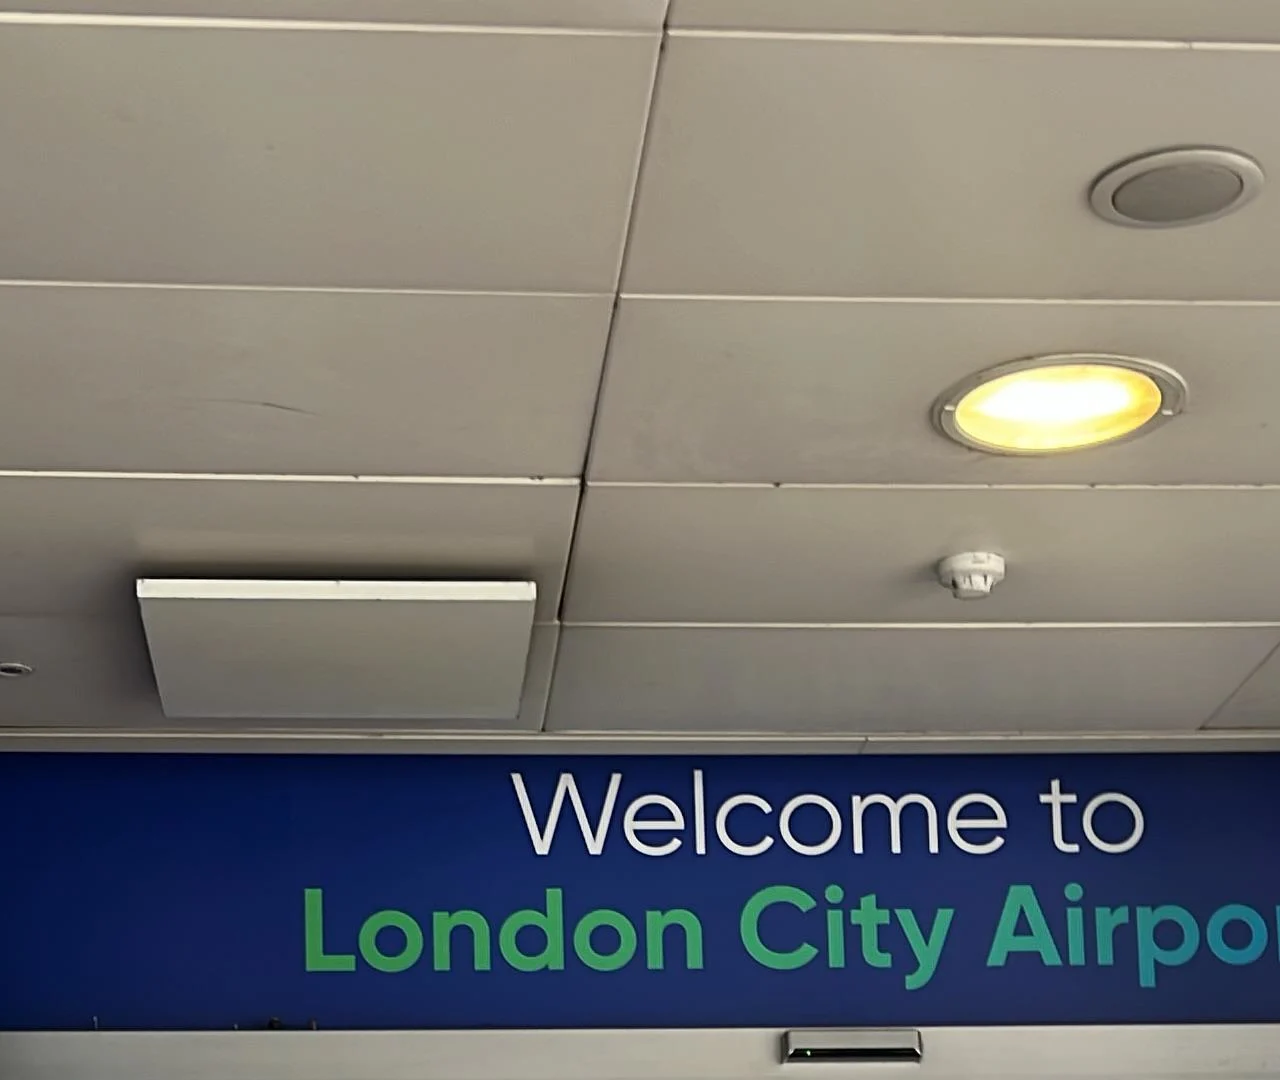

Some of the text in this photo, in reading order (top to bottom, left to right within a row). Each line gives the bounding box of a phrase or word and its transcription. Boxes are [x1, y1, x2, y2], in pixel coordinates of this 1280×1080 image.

[512, 771, 1144, 857] Welcome to
[304, 887, 703, 972] London
[740, 884, 954, 990] City
